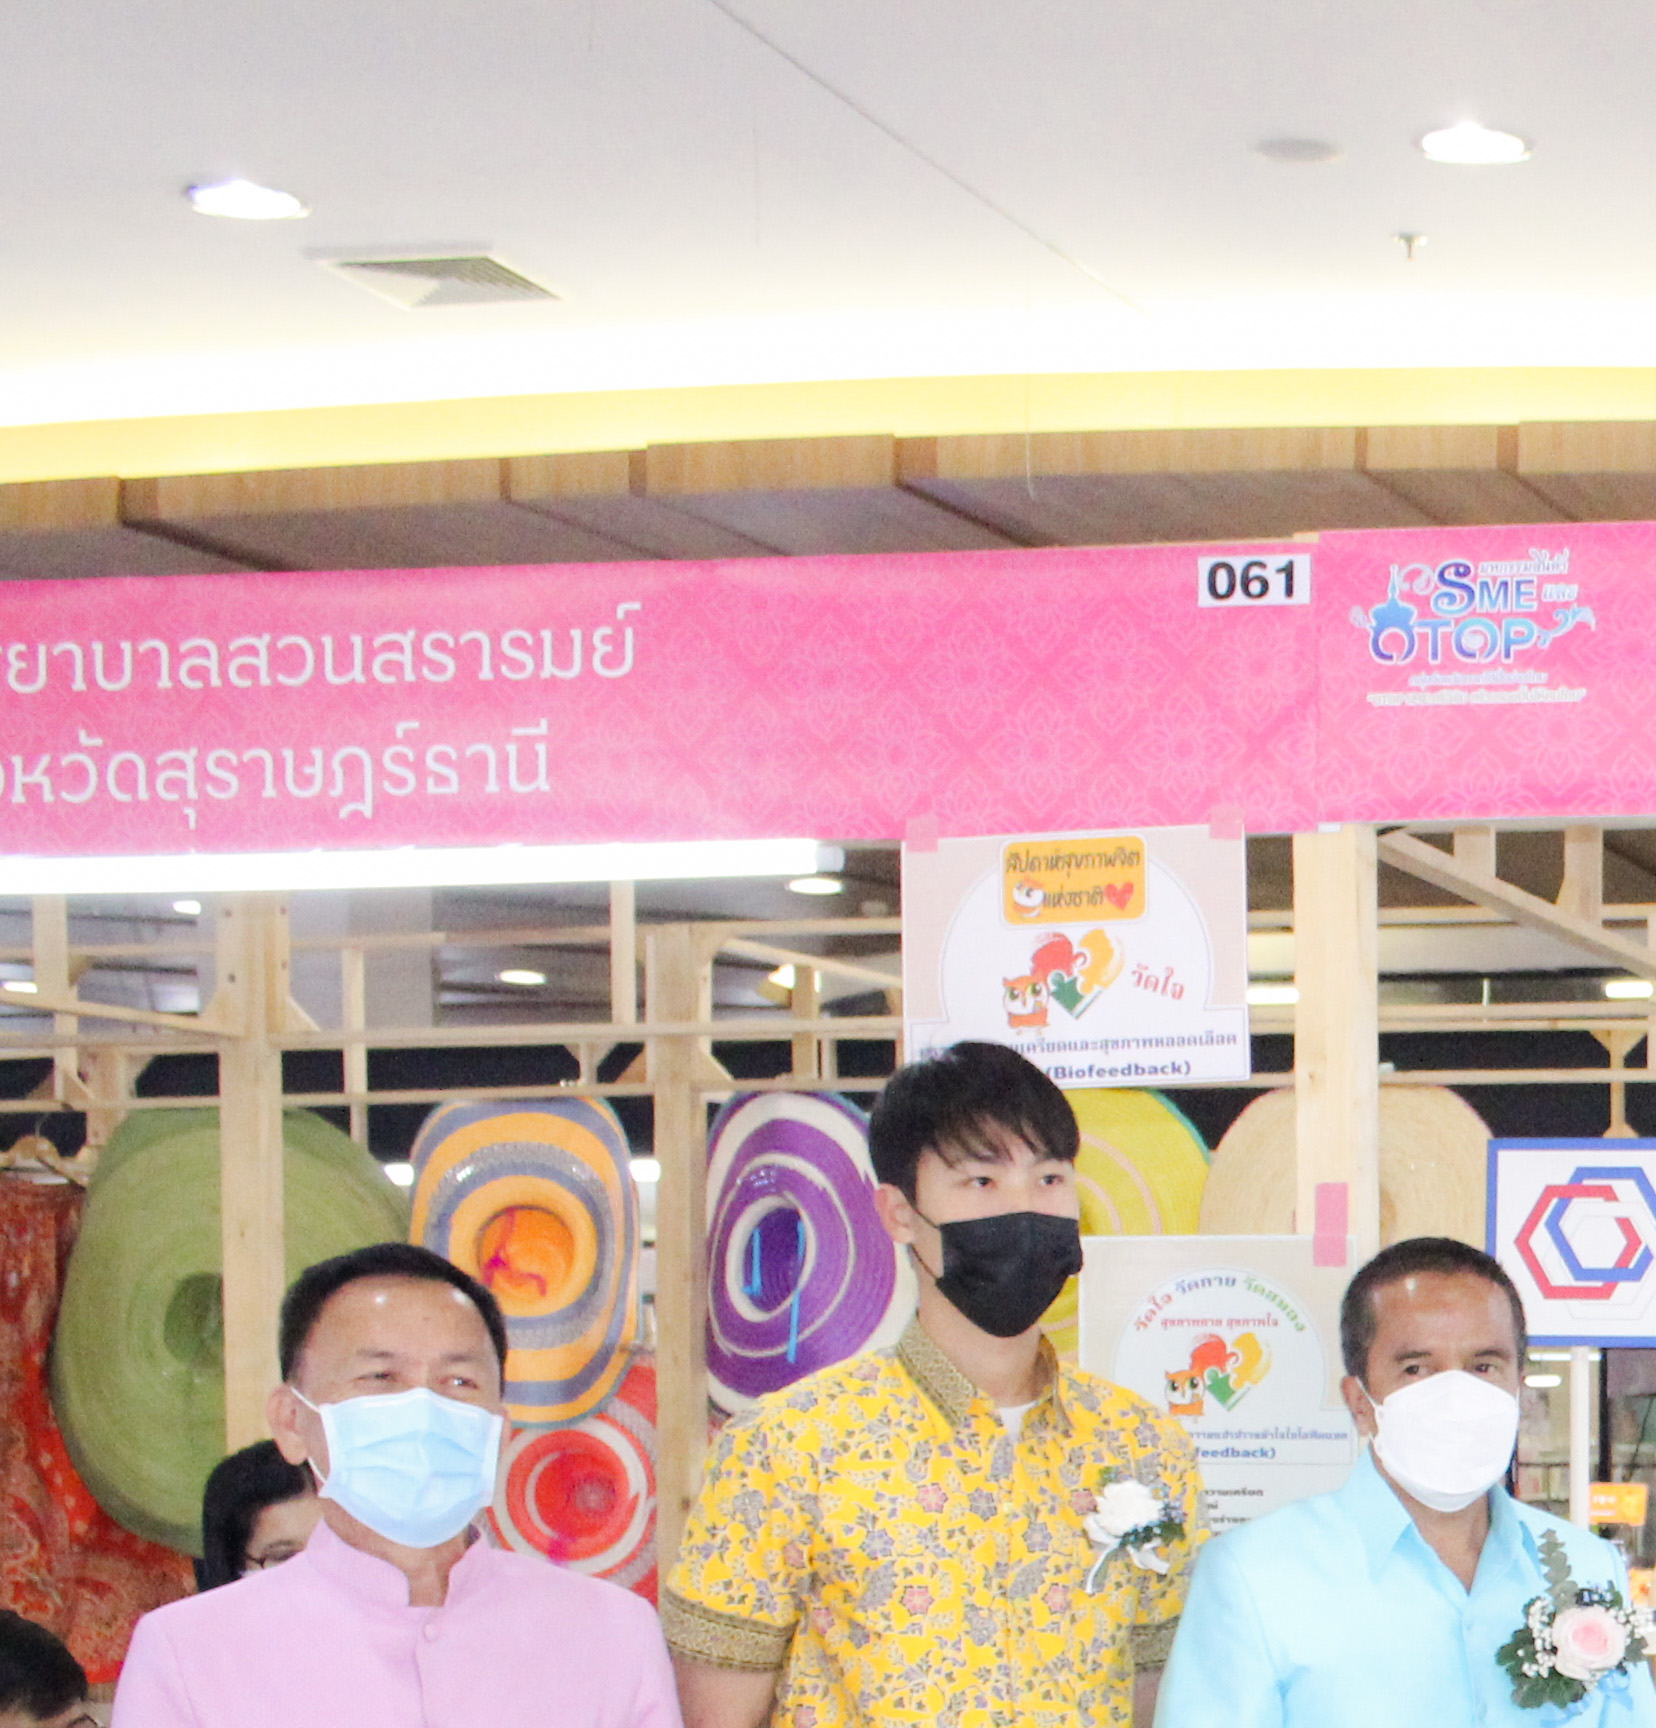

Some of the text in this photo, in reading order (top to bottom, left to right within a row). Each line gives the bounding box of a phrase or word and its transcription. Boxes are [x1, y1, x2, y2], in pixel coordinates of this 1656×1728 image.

[1207, 559, 1297, 600] 061
[1431, 559, 1538, 617] SME
[0, 602, 642, 694] ยาบาลสวนสรารมย์
[1369, 616, 1537, 665] OTOP
[0, 719, 550, 829] หวัดสุราษฎร์ธานี
[1046, 1059, 1192, 1080] (Biofeedback)
[1195, 1446, 1276, 1459] feedback)
